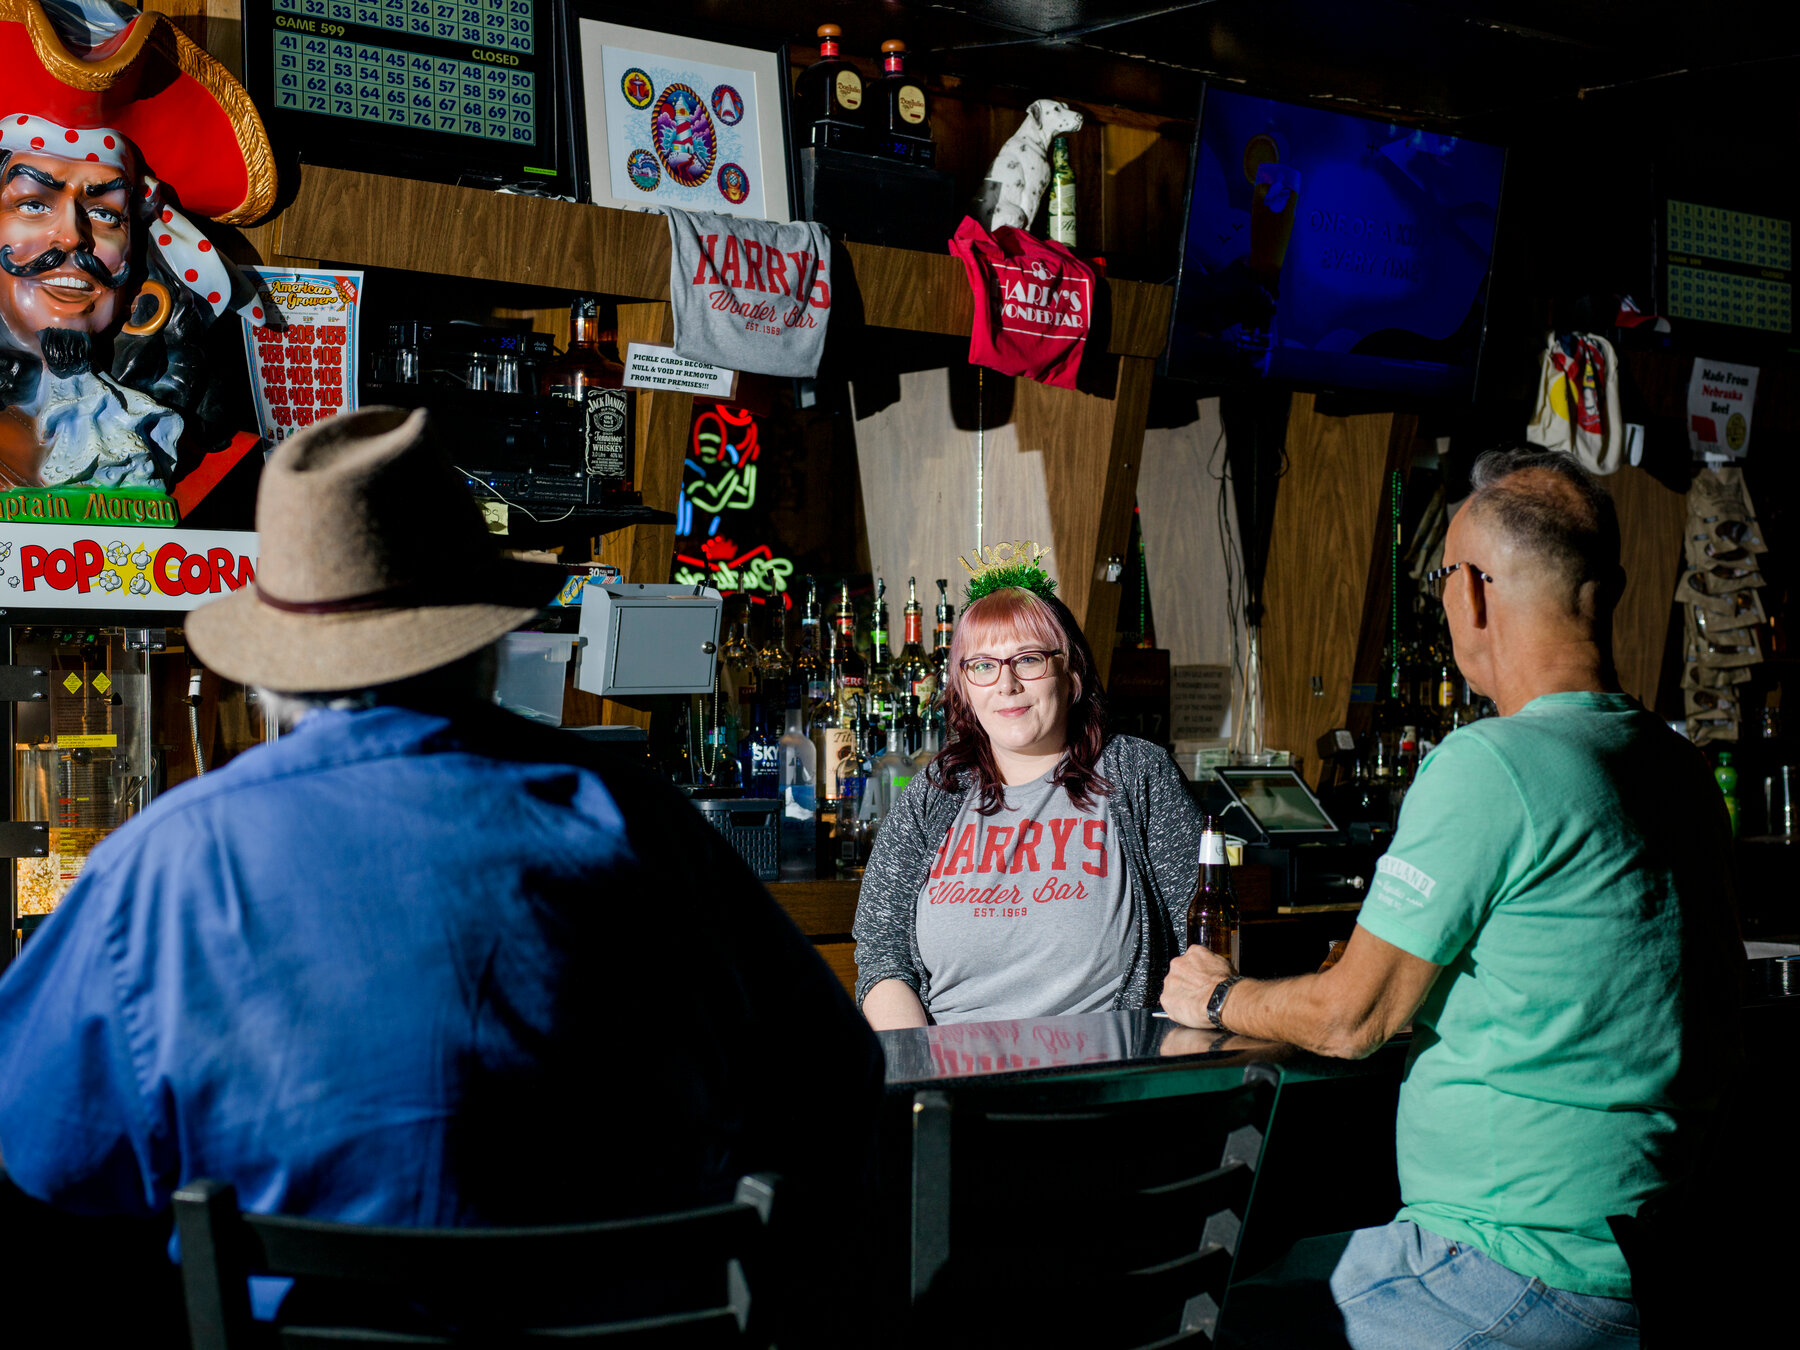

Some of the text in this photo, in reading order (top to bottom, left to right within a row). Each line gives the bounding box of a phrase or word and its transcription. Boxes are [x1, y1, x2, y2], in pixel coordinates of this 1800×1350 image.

[412, 1, 429, 15] 26
[438, 5, 454, 19] 27
[462, 9, 479, 23] 28
[487, 14, 504, 28] 29
[512, 18, 529, 32] 30
[511, 1, 528, 15] 20
[275, 15, 345, 36] GAME 599
[306, 0, 324, 14] 32
[334, 5, 351, 19] 33
[360, 9, 379, 23] 34
[386, 14, 403, 28] 35
[412, 19, 429, 33] 36
[438, 23, 455, 37] 37
[463, 27, 480, 41] 38
[488, 32, 504, 46] 39
[510, 36, 530, 50] 40
[280, 36, 529, 88] 41 42 43 44 45 46 47 48 49 50
[472, 49, 519, 66] CLOSED
[282, 54, 530, 106] 51 52 53 54 55 56 57 58 59 60
[281, 73, 530, 124] 61 62 63 64 65 66 67 68 69 70
[283, 92, 531, 142] 71 72 73 74 75 76 77 78 79 80
[692, 234, 831, 310] HARRY'S
[270, 280, 332, 296] American
[287, 292, 338, 310] Growers
[709, 289, 818, 328] Wonder Bar
[283, 324, 315, 345] $205
[316, 326, 346, 346] $155
[258, 344, 342, 366] $155 $105 $105
[633, 353, 714, 370] PICKLE CARDS BECOME
[261, 365, 343, 387] $105 $105 $105
[630, 374, 710, 390] FROM THE PREMISES!!!
[632, 364, 650, 372] NULL
[657, 367, 675, 376] VOID
[683, 371, 718, 380] REMOVED
[1703, 369, 1749, 386] Made From
[264, 386, 343, 407] $105 $105 $105
[1702, 385, 1743, 401] Nebraska
[587, 397, 605, 414] JACK
[1711, 402, 1730, 415] Beef
[271, 406, 292, 426] $55
[292, 407, 314, 427] $55
[592, 443, 624, 453] WHISKEY
[0, 492, 176, 523] ptain Morgan
[20, 539, 104, 594] POP
[588, 567, 600, 577] 30
[929, 876, 1089, 905] Wonder Bar
